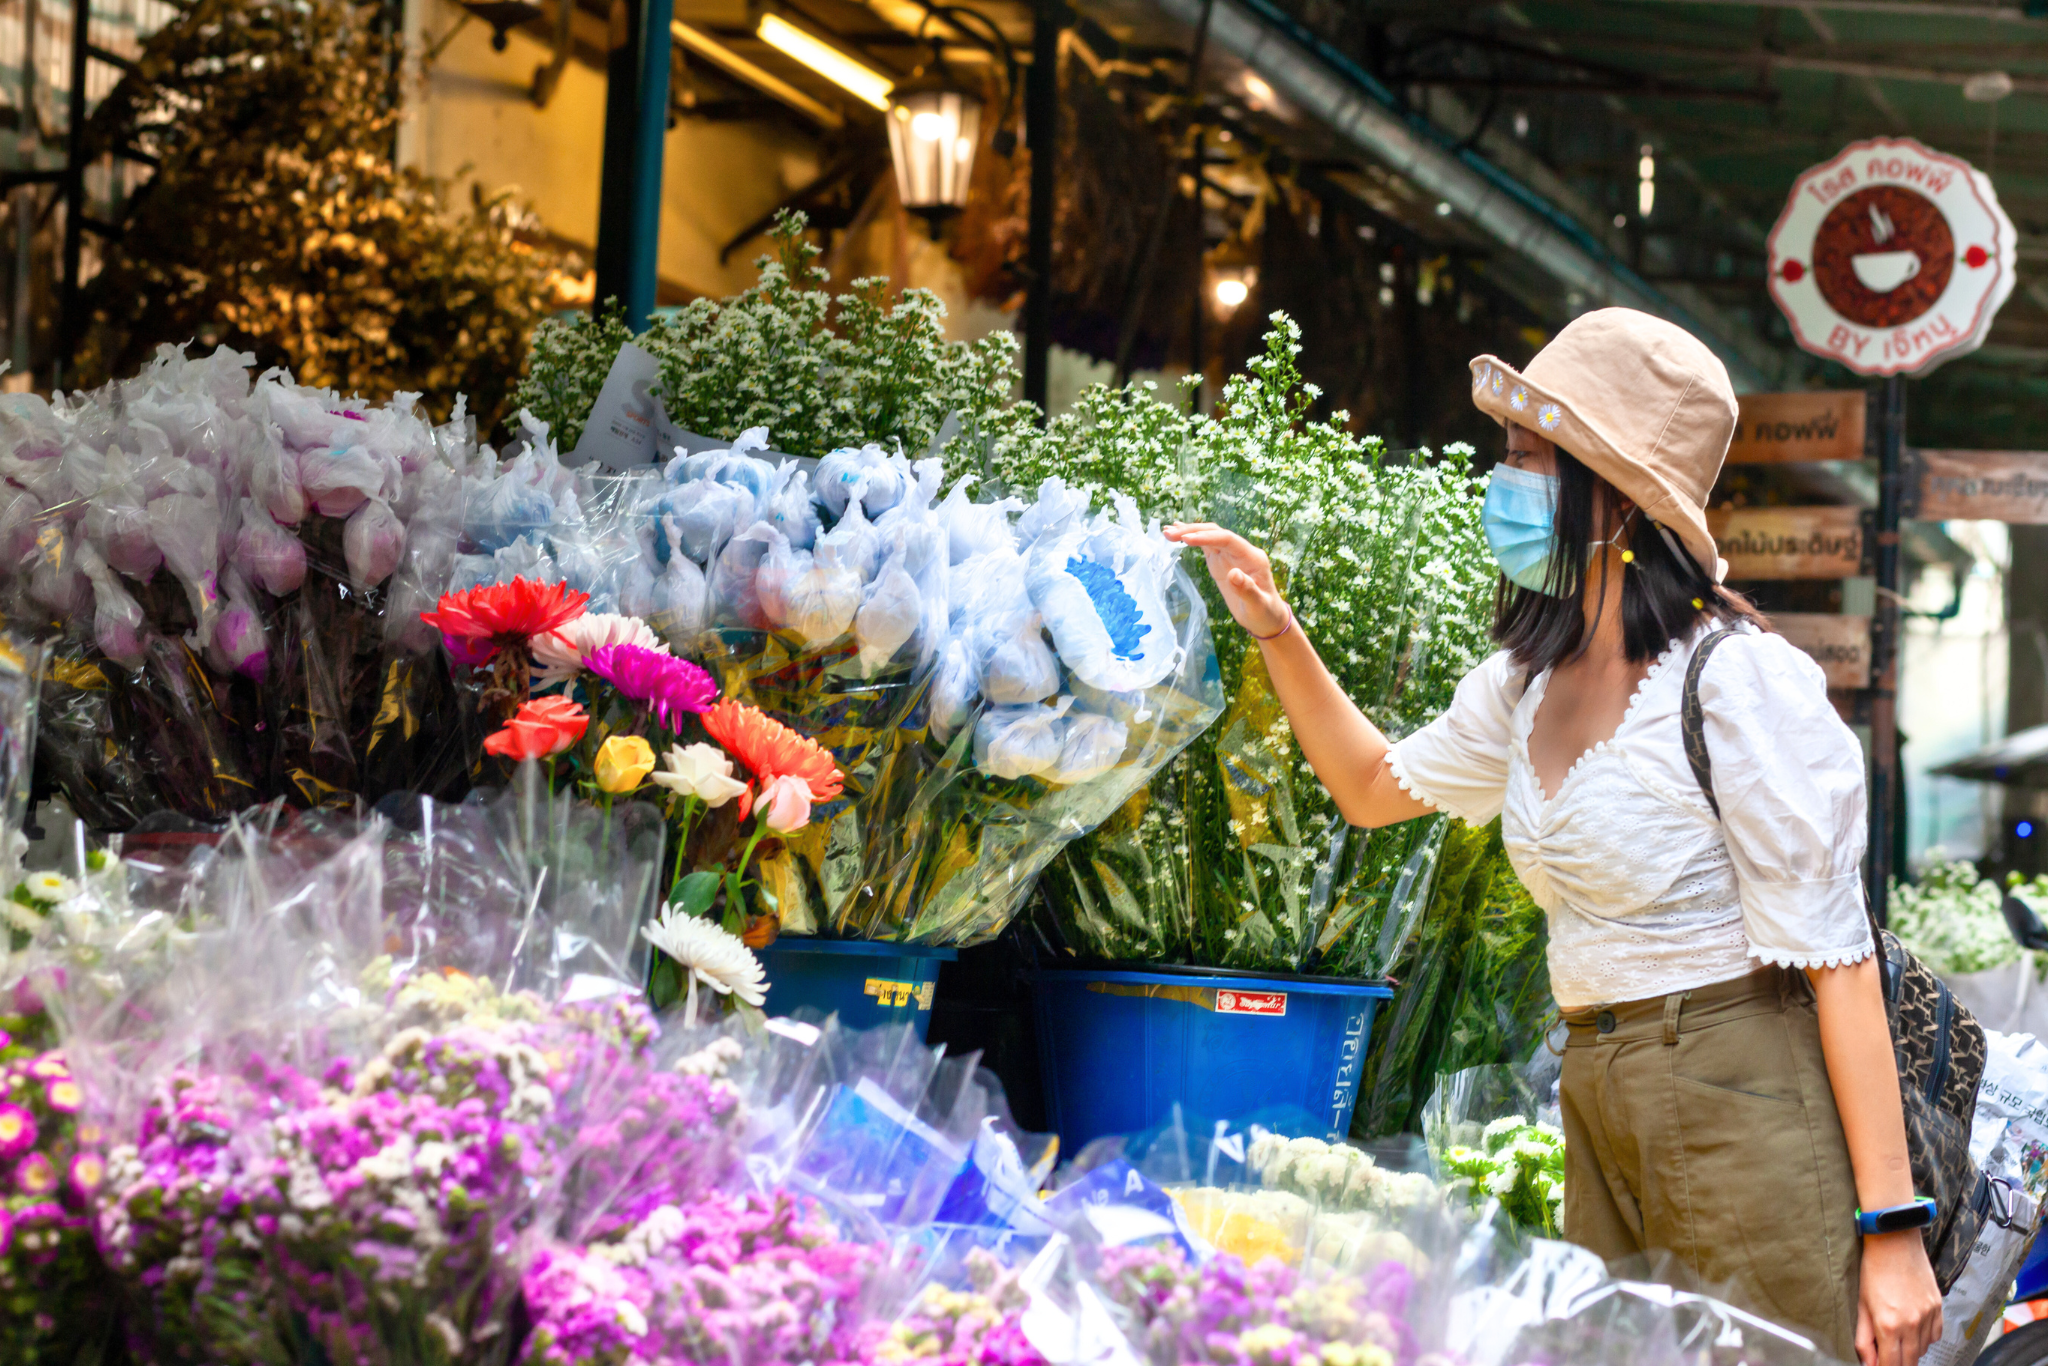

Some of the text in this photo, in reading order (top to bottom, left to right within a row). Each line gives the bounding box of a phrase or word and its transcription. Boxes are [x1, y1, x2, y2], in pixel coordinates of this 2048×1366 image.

[1827, 322, 1871, 357] BY
[2000, 1089, 2023, 1111] 규모
[2024, 1103, 2048, 1128] 국립
